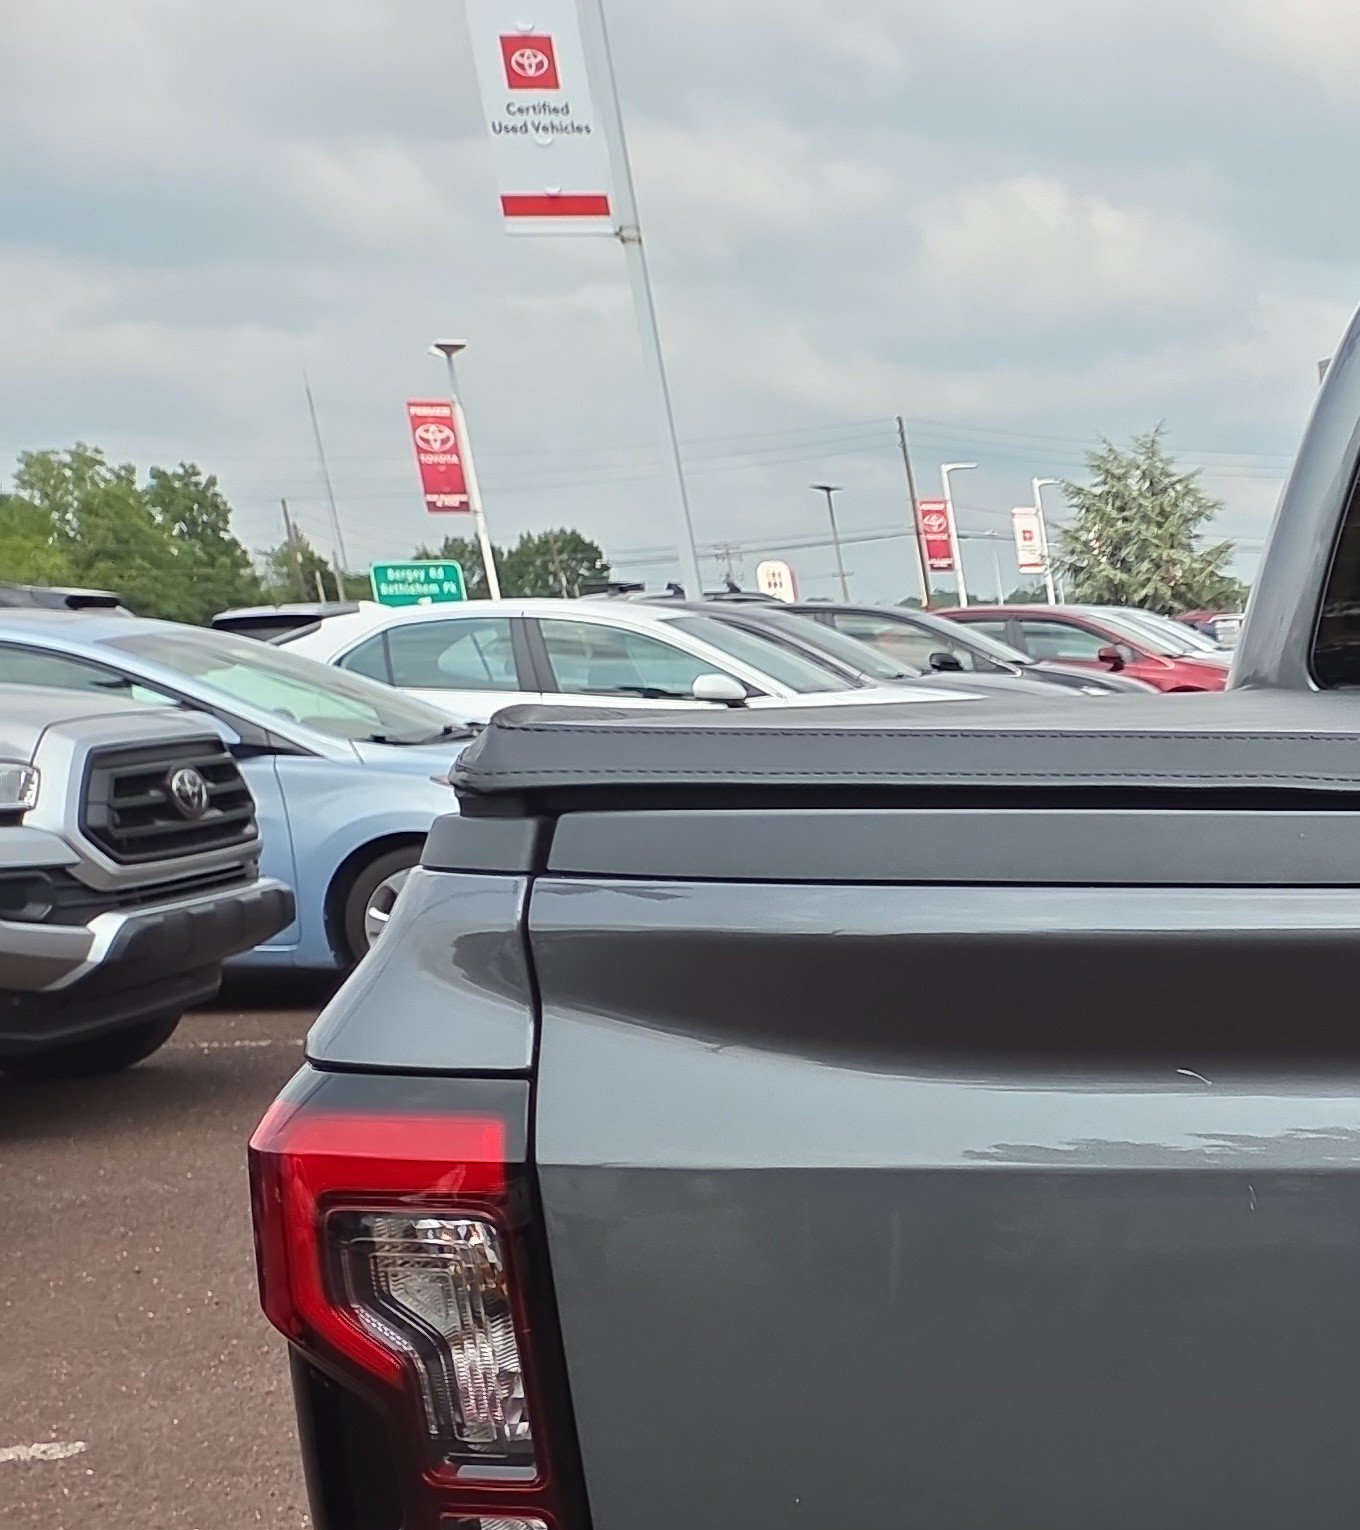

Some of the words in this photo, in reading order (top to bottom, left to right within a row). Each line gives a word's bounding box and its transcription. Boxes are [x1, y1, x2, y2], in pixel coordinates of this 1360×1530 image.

[506, 100, 570, 116] Certified
[491, 120, 528, 135] Used
[530, 120, 592, 135] Vehicles
[419, 453, 460, 465] TOYOTA
